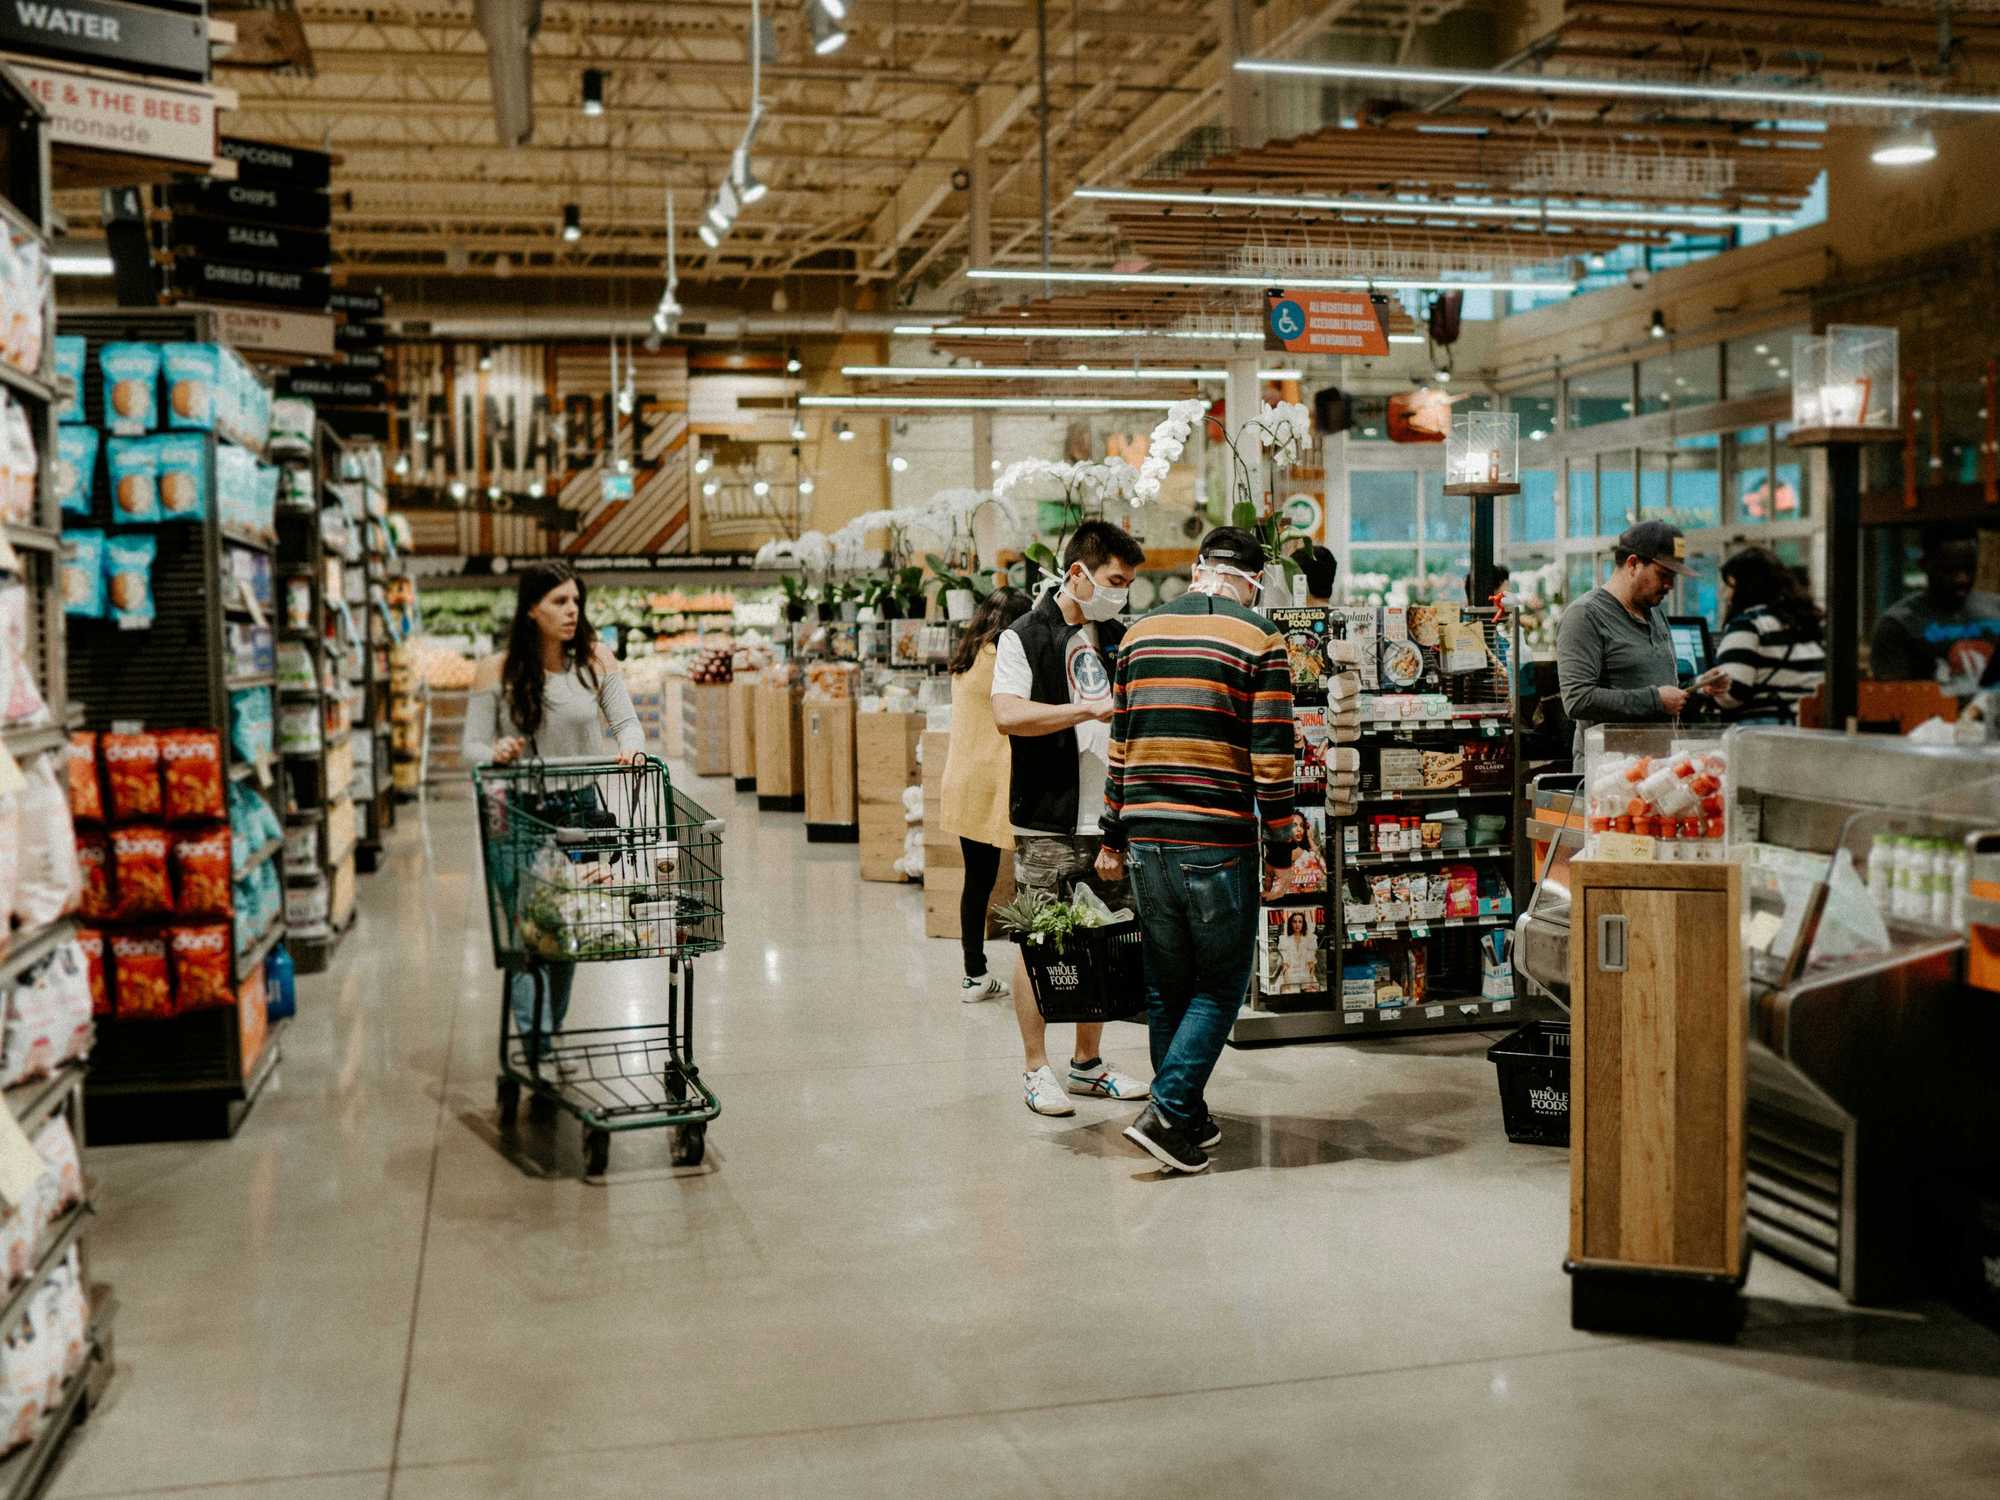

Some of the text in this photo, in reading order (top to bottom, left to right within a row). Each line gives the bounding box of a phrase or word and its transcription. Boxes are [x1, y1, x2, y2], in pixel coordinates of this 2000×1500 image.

[17, 2, 120, 42] WATER
[63, 83, 80, 105] &
[88, 87, 136, 114] THE
[144, 98, 201, 124] BEES
[49, 113, 152, 144] monade
[229, 187, 277, 208] CHIPS
[228, 227, 279, 248] SALSA
[204, 264, 302, 291] DRIED FRUIT
[1856, 376, 1872, 427] 7
[1272, 612, 1326, 622] PLANT-BASED
[1288, 619, 1312, 628] FOOD
[106, 741, 159, 763] dang
[162, 742, 216, 762] dang
[114, 838, 165, 858] dang
[175, 841, 225, 860] dang
[112, 939, 165, 956] dang
[173, 934, 223, 951] dang
[1046, 964, 1078, 976] WHOLE
[1050, 975, 1079, 985] FOODS
[1528, 1088, 1568, 1102] WHOLE
[1531, 1100, 1568, 1111] FOODS
